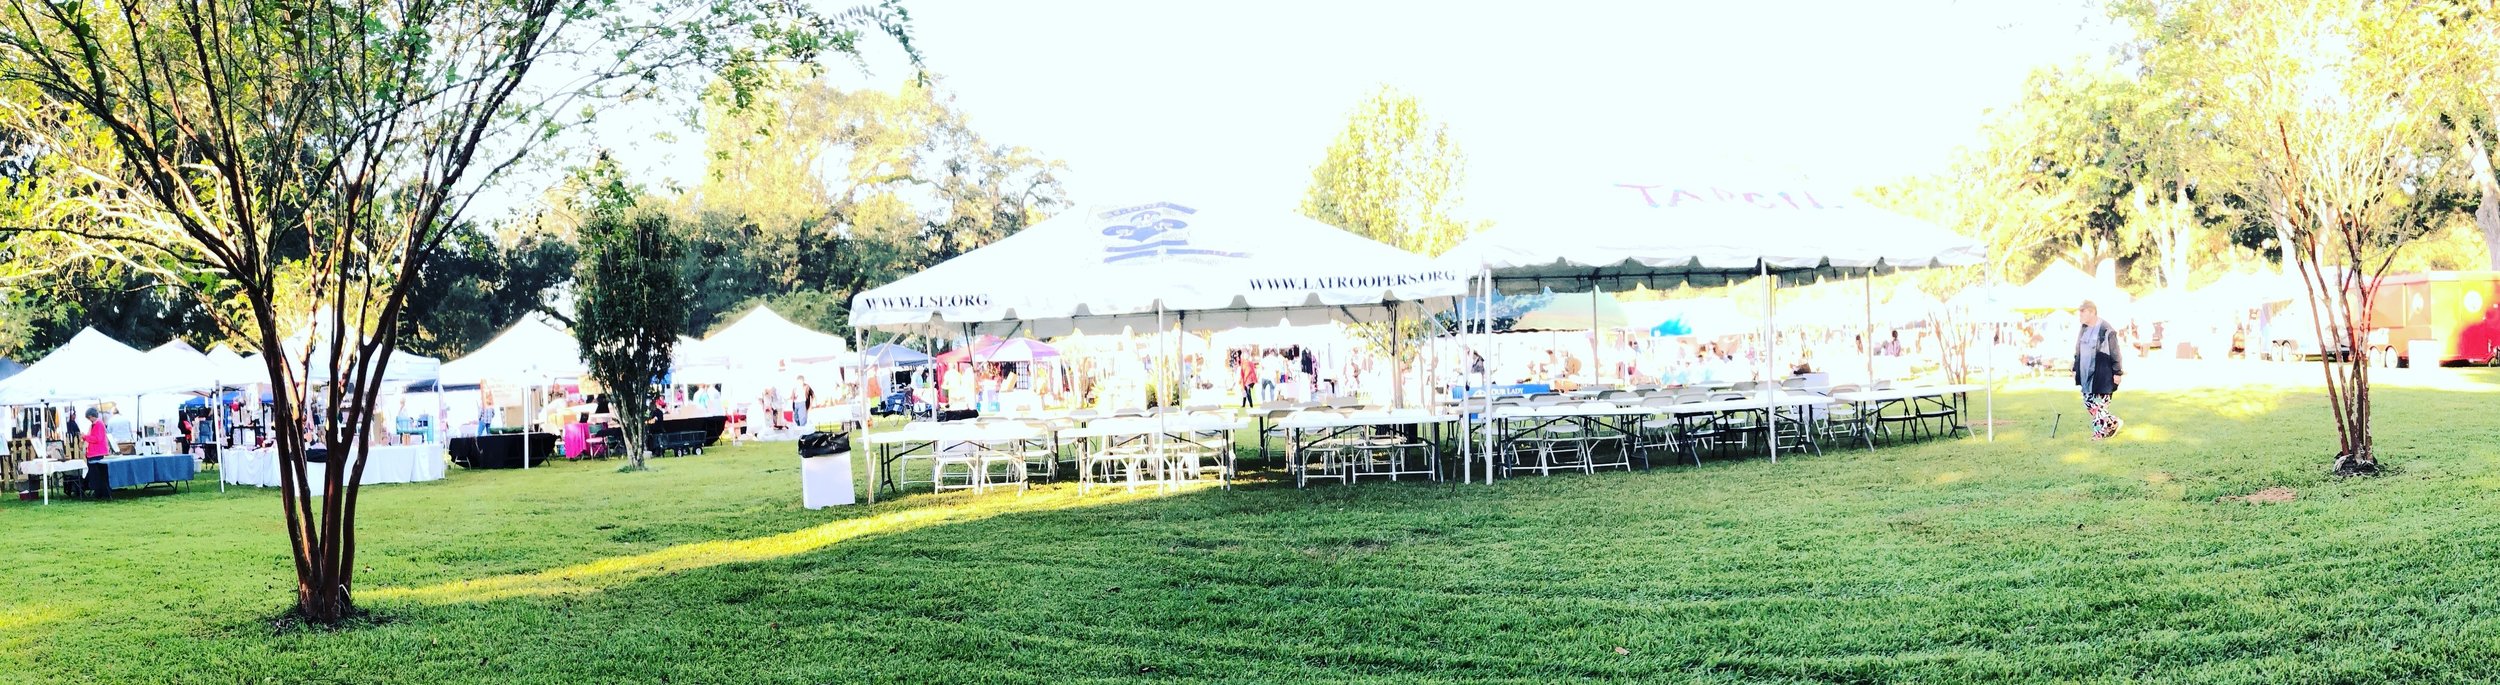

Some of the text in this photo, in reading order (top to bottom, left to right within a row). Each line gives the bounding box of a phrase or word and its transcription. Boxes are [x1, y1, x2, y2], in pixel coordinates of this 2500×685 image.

[1249, 270, 1456, 291] WWW.LATROOPERS.ORG
[865, 293, 988, 310] WWW.LSP.ORG
[1507, 387, 1524, 395] LADY
